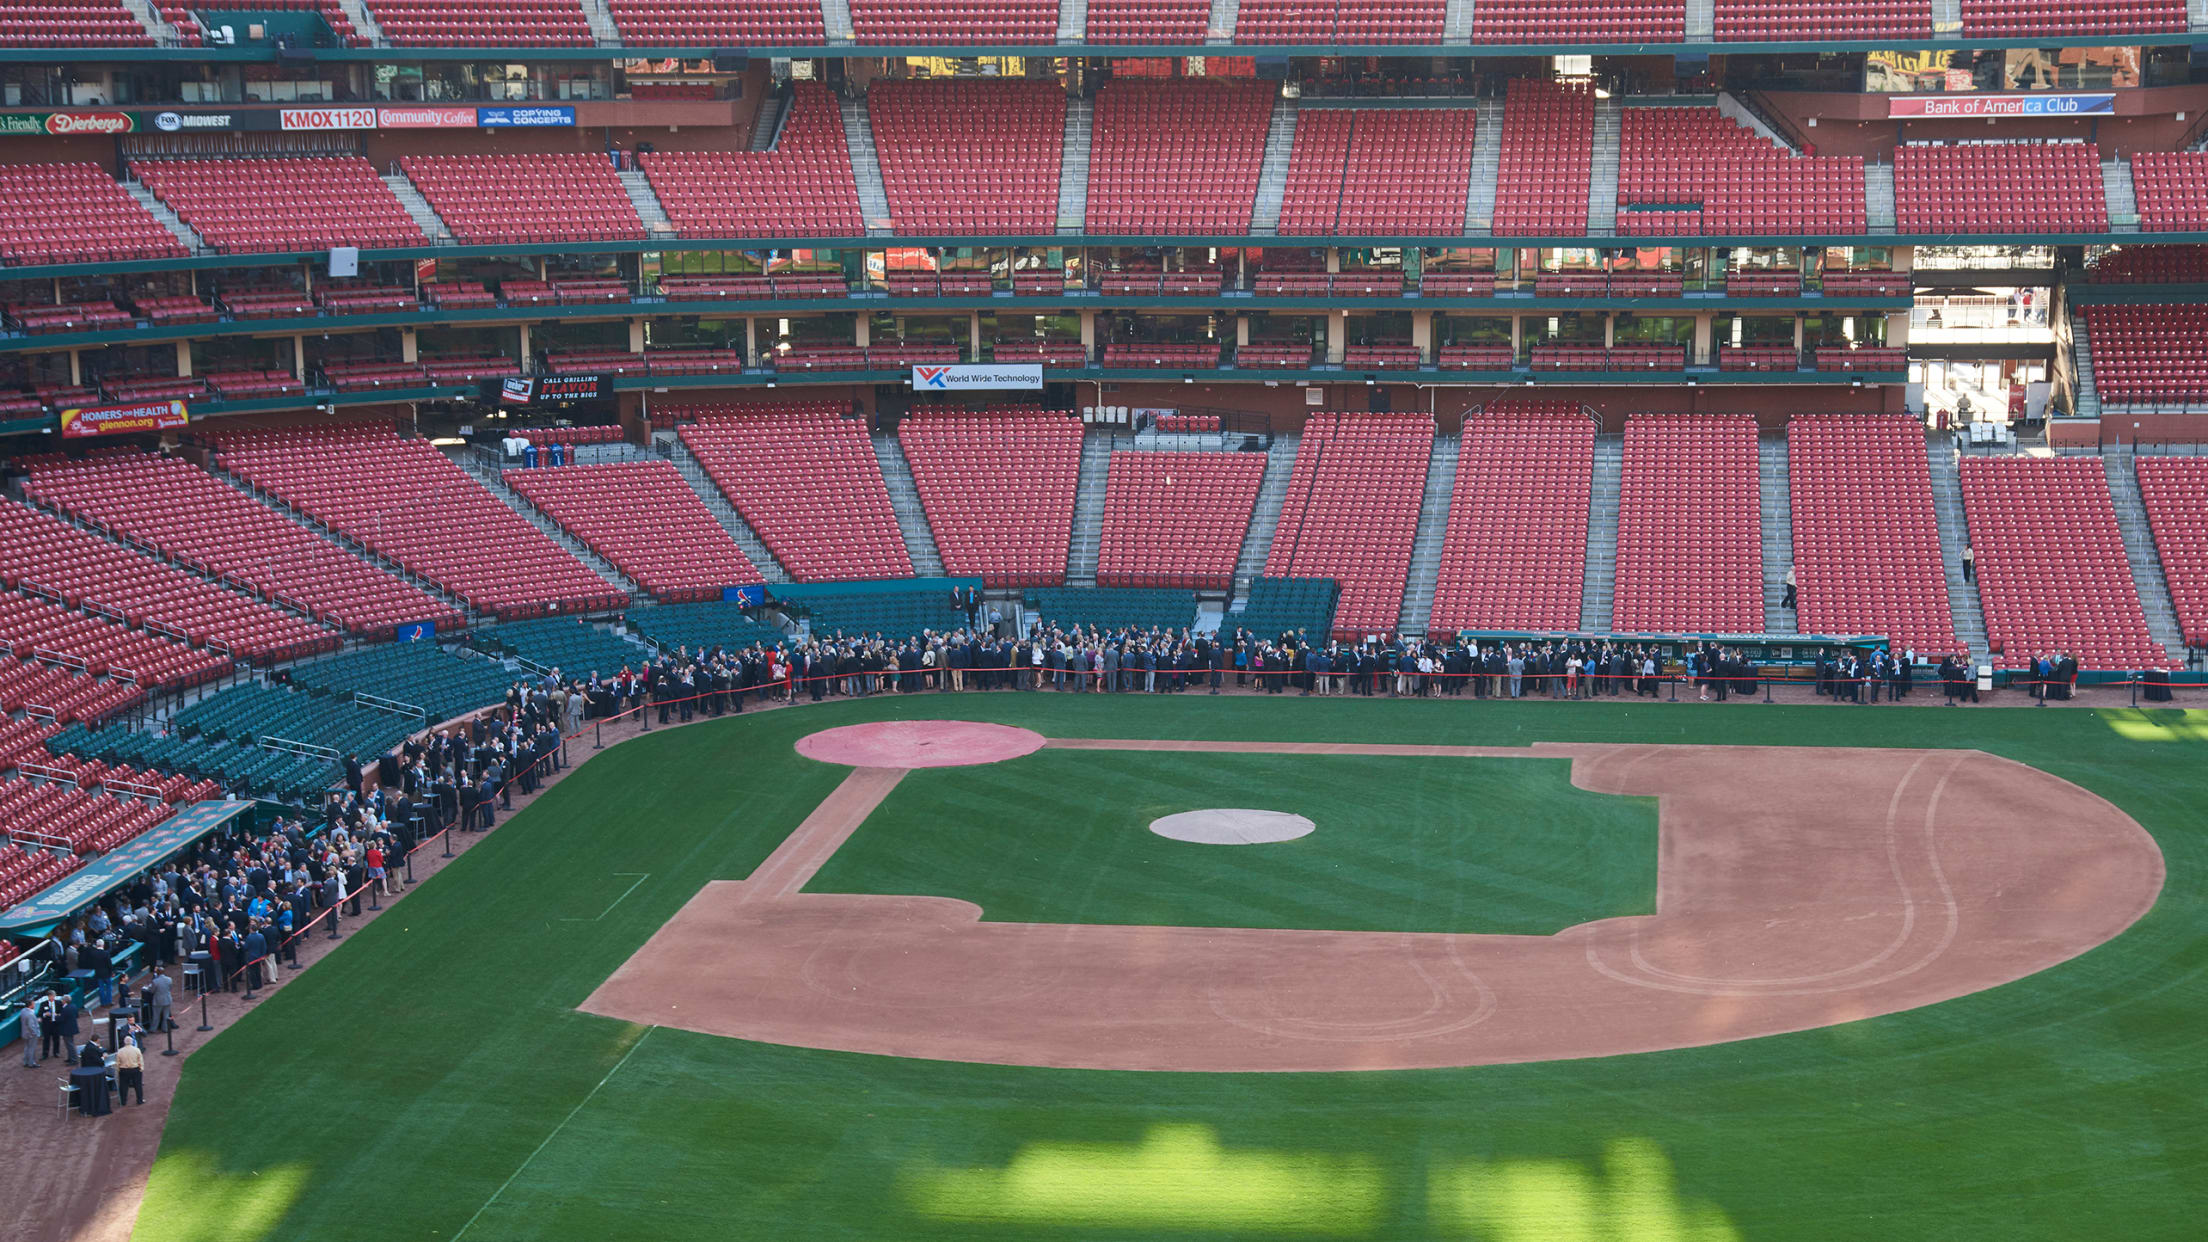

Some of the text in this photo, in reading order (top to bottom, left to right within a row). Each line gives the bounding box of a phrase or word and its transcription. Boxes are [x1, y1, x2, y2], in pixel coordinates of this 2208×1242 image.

[1925, 97, 2078, 114] Bank of America Club
[379, 109, 474, 126] Community Coffee
[512, 108, 561, 117] COPYING
[55, 113, 124, 133] Dierbergs
[183, 115, 231, 127] MIDWEST
[512, 116, 572, 124] CONCEPTS
[946, 374, 1040, 384] World Wide Technology
[542, 382, 598, 393] FLAVOR
[81, 410, 122, 421] HOMERS
[133, 406, 168, 417] HEALTH
[98, 419, 153, 431] glennon.org
